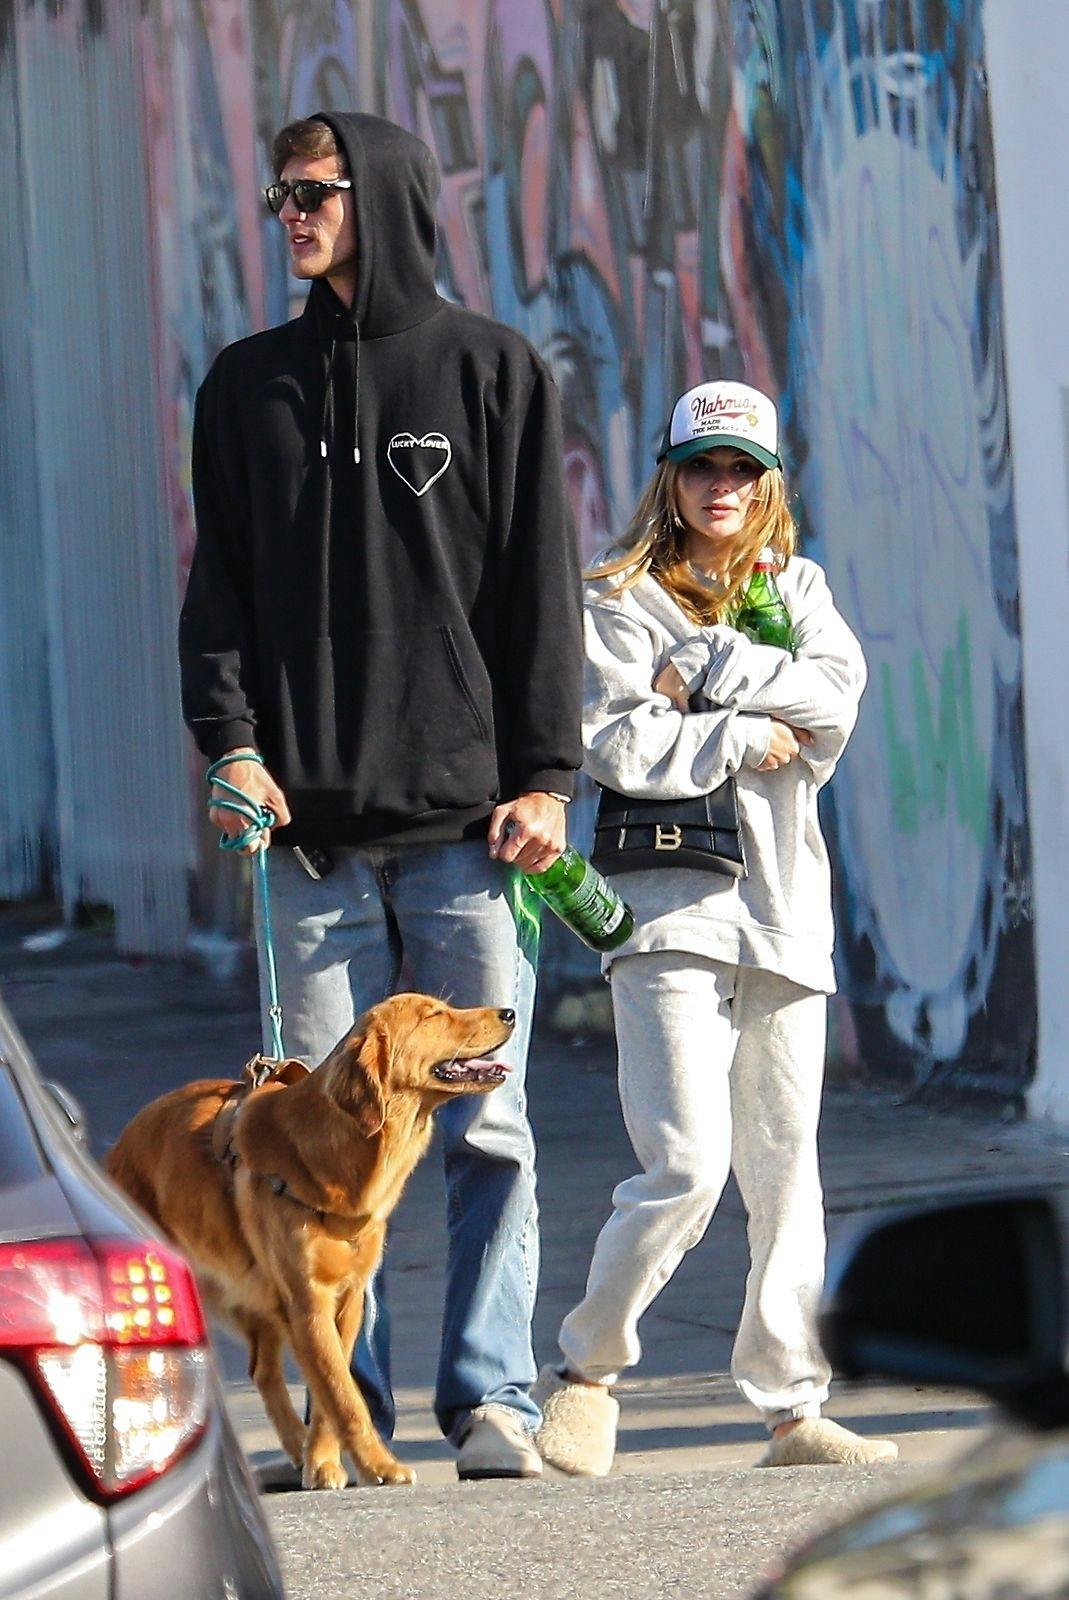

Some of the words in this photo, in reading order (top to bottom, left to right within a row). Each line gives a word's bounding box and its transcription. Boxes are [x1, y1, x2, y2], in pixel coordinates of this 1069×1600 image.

[391, 440, 415, 448] LUCKY
[420, 440, 448, 450] LOVER
[655, 824, 682, 851] B
